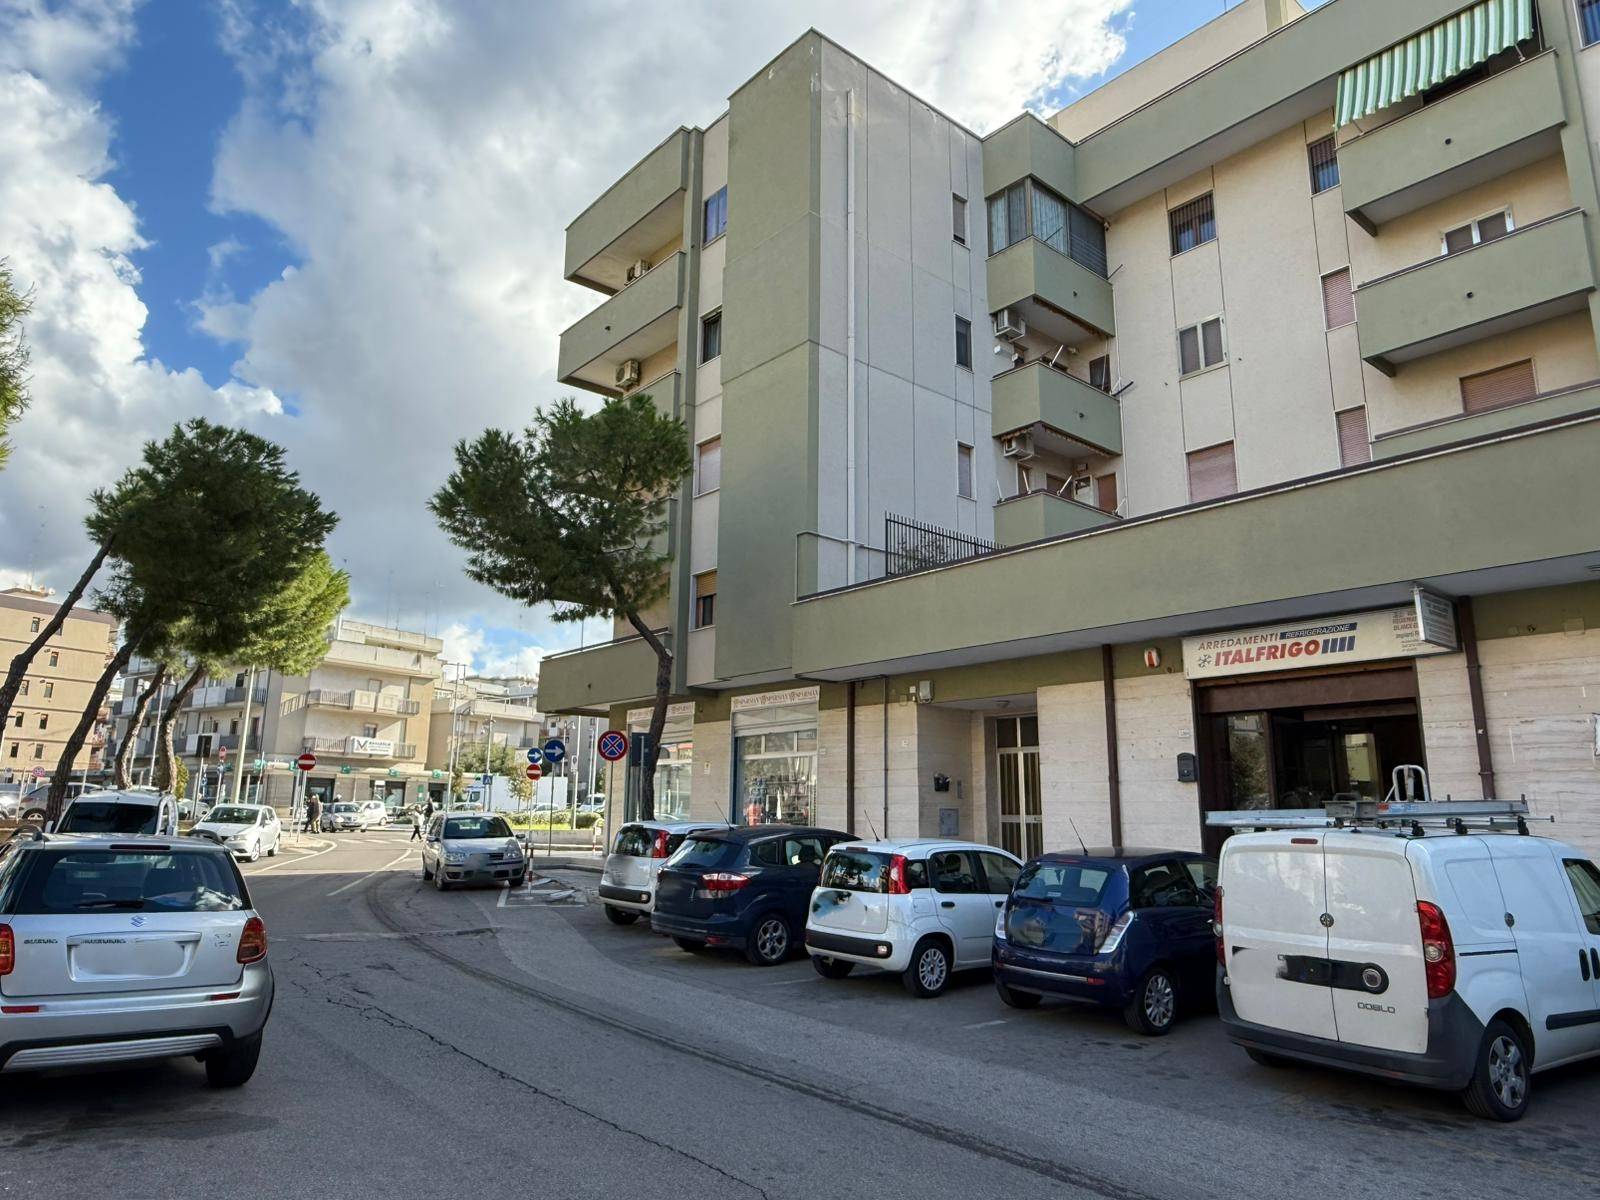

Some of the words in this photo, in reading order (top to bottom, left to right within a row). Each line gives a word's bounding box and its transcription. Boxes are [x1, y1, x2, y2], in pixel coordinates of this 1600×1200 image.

[1286, 623, 1351, 640] REFRIGERAZIONE
[1198, 632, 1279, 651] ARREDAMENTI
[1214, 639, 1320, 667] ITALFRIGO
